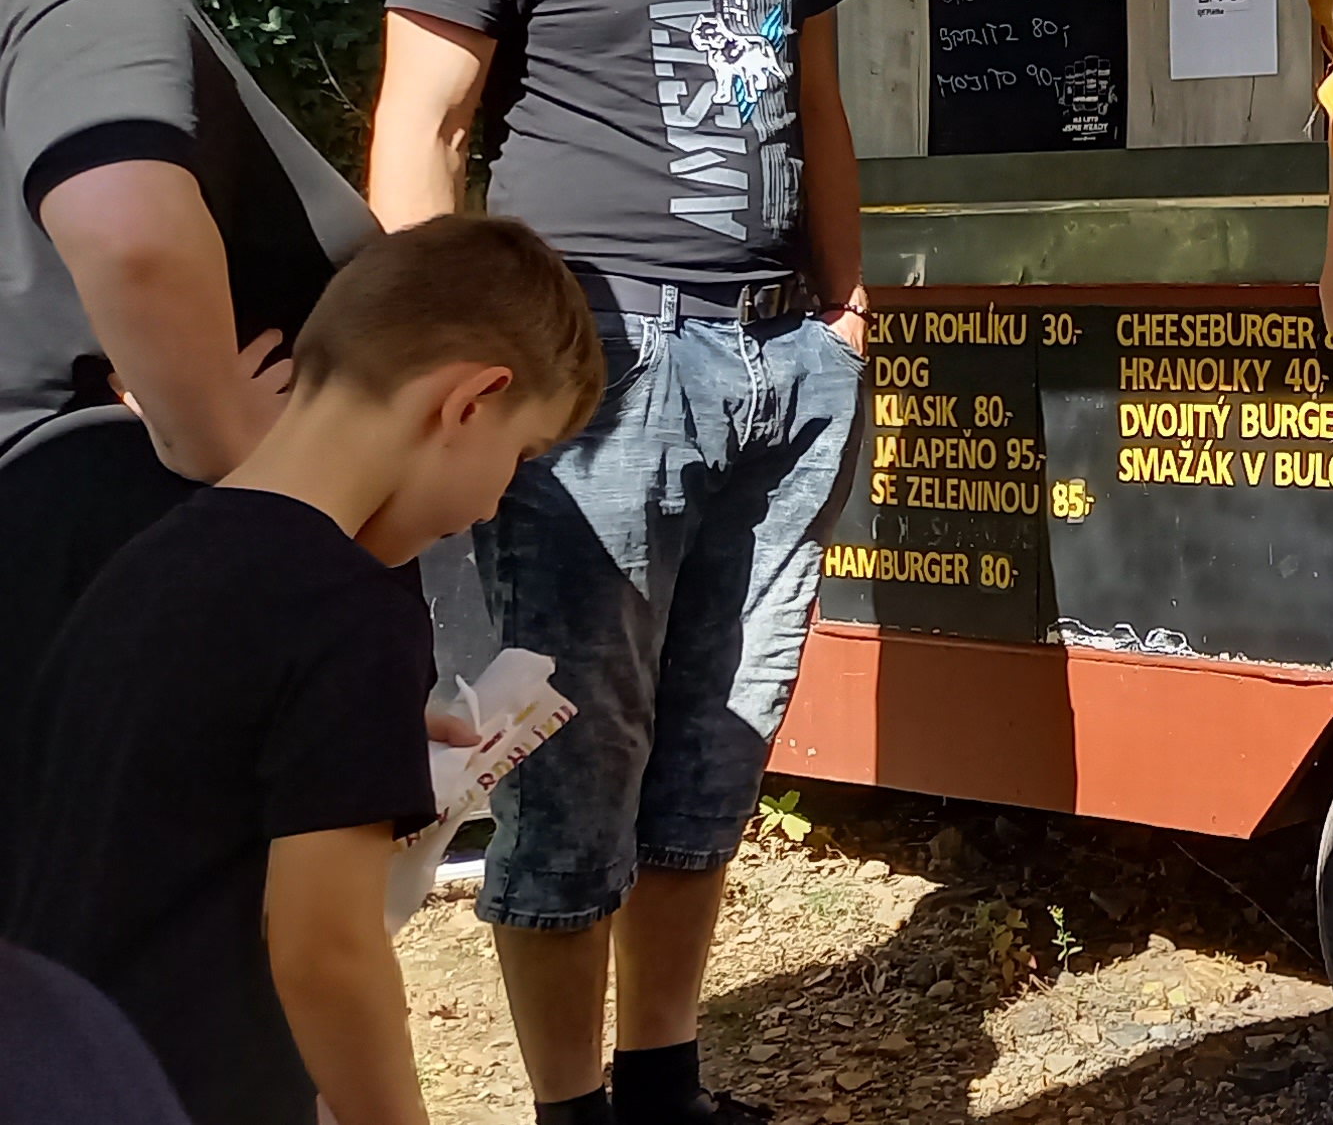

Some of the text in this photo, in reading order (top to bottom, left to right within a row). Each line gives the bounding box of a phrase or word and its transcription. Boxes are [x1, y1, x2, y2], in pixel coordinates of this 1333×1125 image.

[939, 22, 1019, 51] SPRITZ
[937, 68, 1017, 98] MOJITO
[899, 313, 918, 344] V
[925, 303, 1028, 346] ROHLÍKU
[1041, 312, 1083, 347] 30,-
[1117, 313, 1317, 350] CHEESEBURGER
[875, 356, 929, 387] DOG
[1119, 357, 1330, 395] HRANOLKY 40,-
[874, 395, 1013, 428] KLASIK 80,-
[1119, 396, 1231, 439] DVOJITÝ
[1006, 438, 1047, 472] 95,-
[1119, 435, 1234, 486] SMAŽÁK
[1243, 452, 1264, 486] V
[870, 472, 1096, 519] SE ZELENINOU 85,-
[824, 544, 1020, 589] HAMBURGER 80,-
